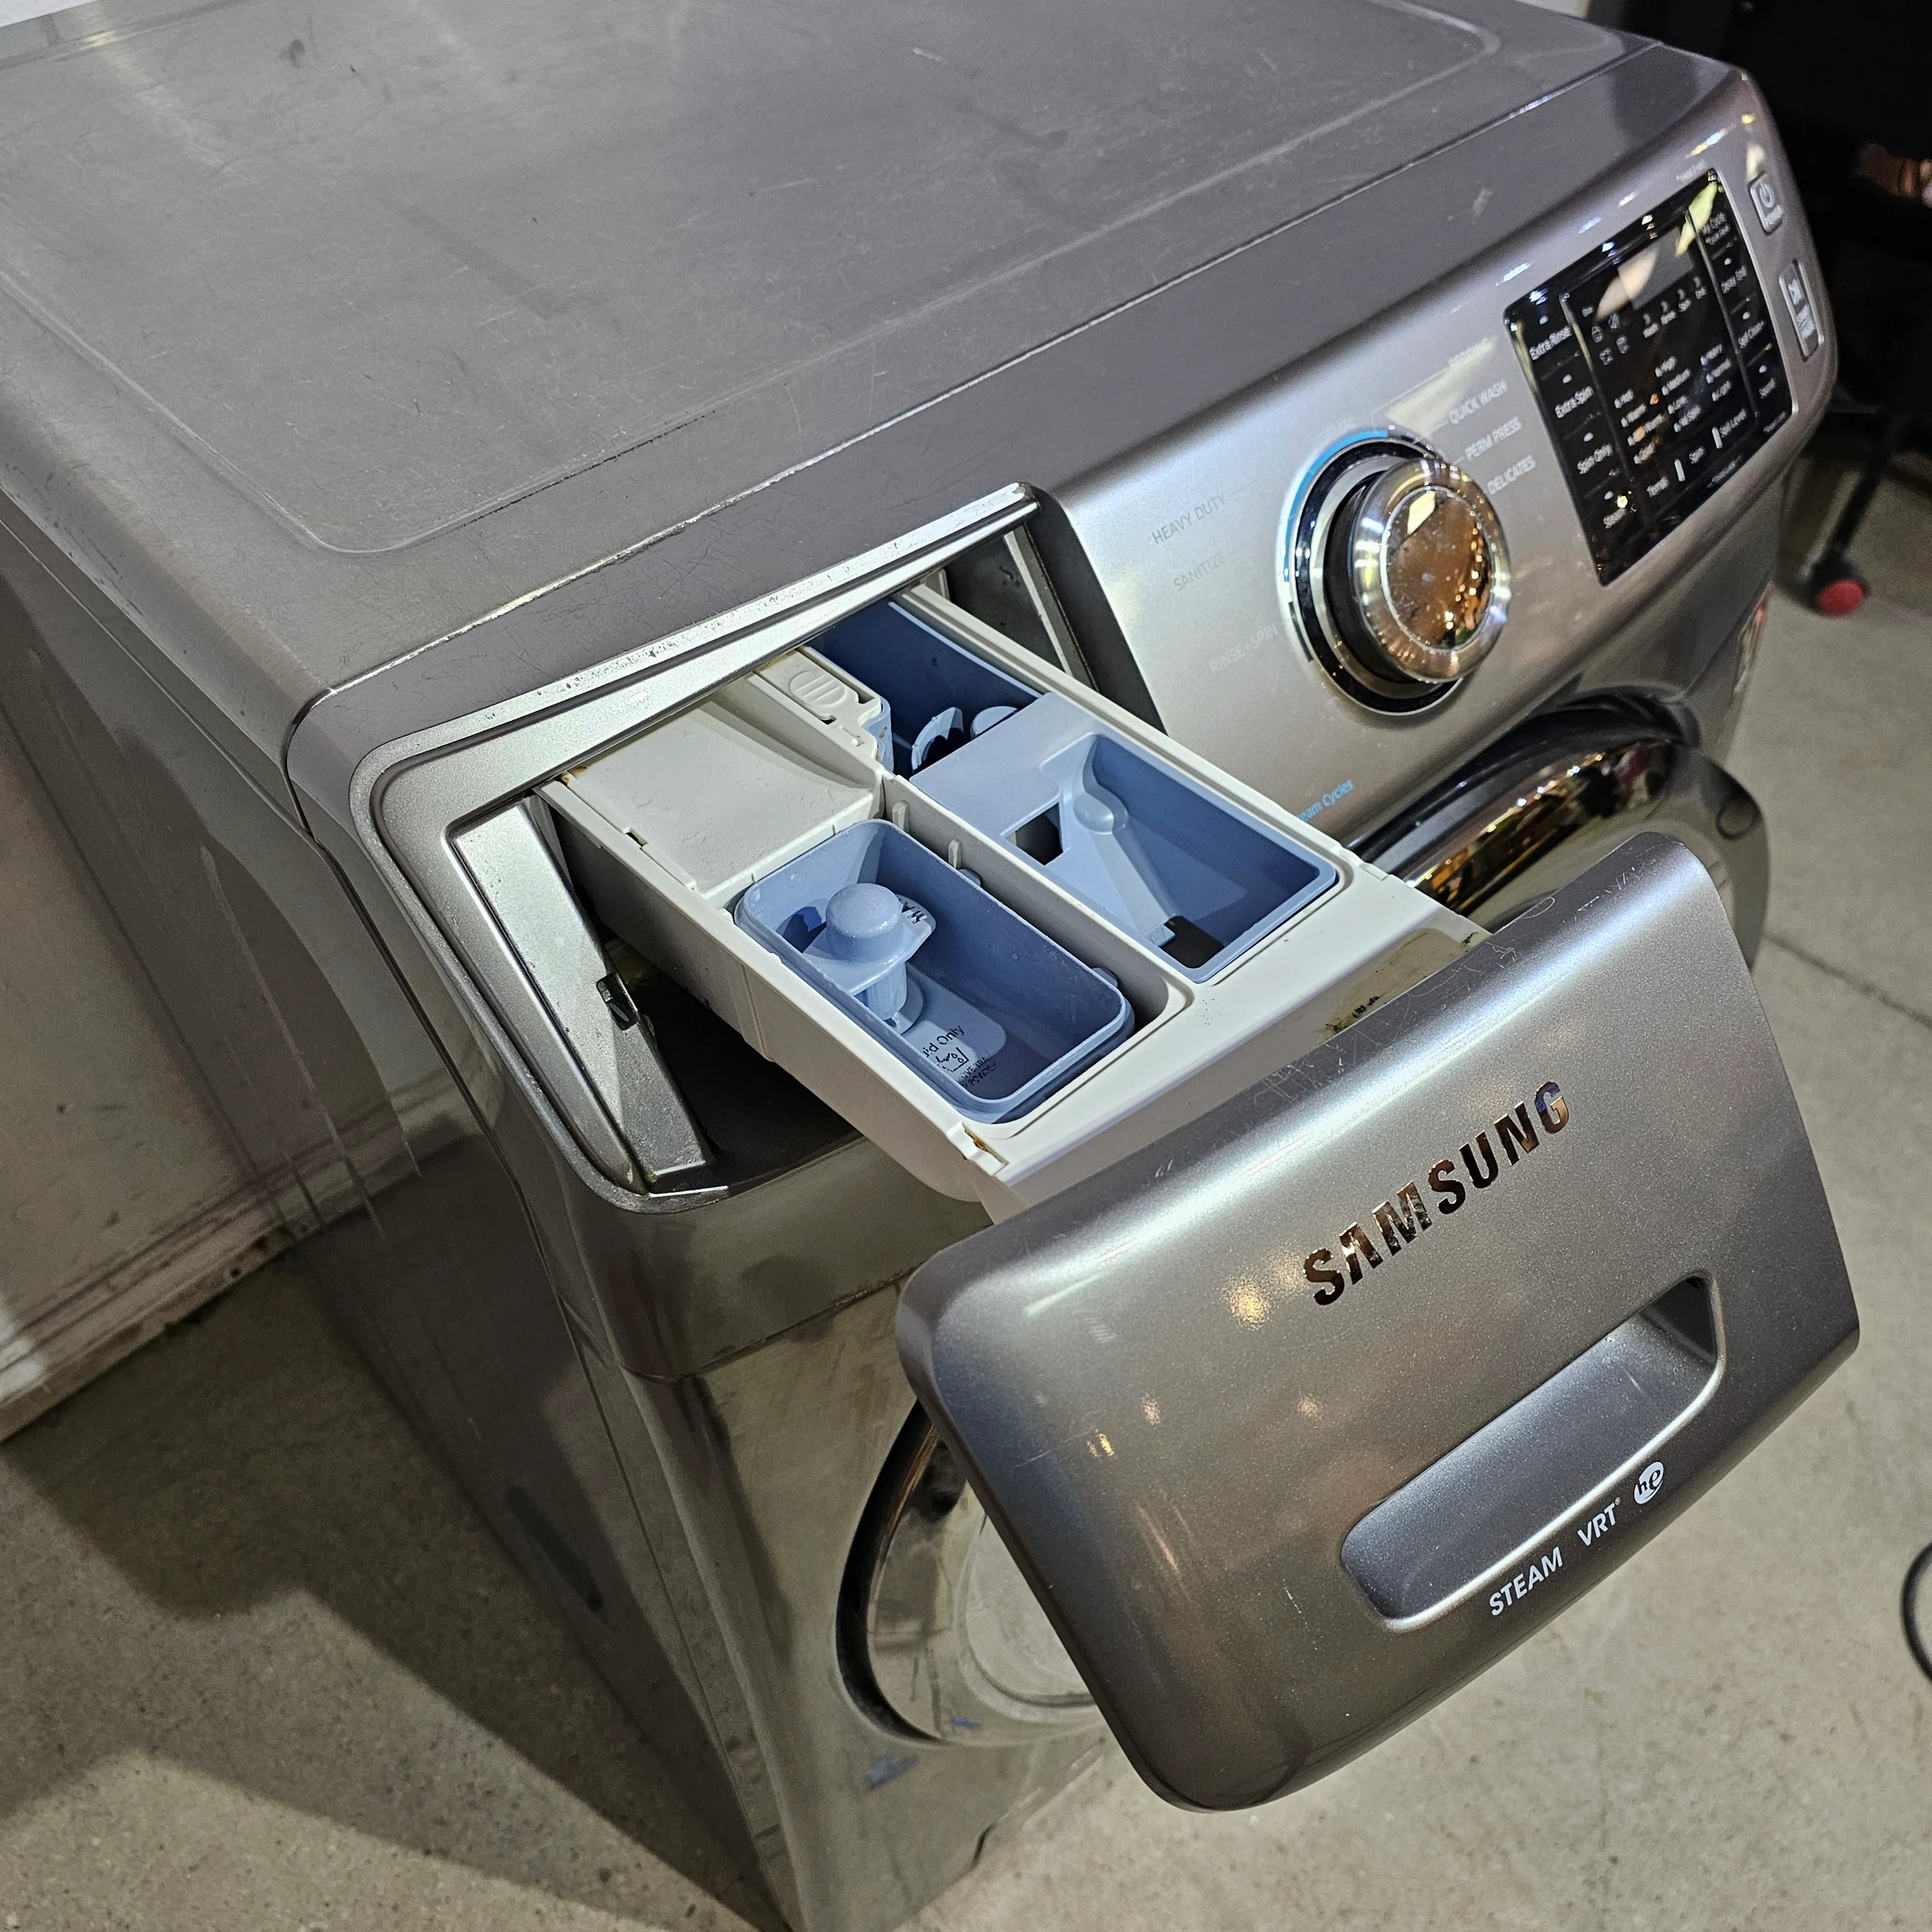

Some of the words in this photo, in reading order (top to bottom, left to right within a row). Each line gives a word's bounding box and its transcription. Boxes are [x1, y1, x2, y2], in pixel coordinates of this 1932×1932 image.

[1529, 339, 1552, 360] Extra
[1548, 325, 1572, 347] Rinse
[1449, 396, 1479, 424] QUICK
[1480, 379, 1510, 406] WASH
[1554, 395, 1578, 418] Extra
[1574, 386, 1593, 406] Spin
[1464, 434, 1494, 461] PERM
[1493, 415, 1523, 444] PRESS
[1486, 454, 1537, 495] DELICATES
[1151, 511, 1192, 545] HEAVY
[1195, 491, 1226, 520] DUTY
[1173, 552, 1226, 591] SANITIZE
[1297, 802, 1322, 822] eam
[1322, 780, 1353, 807] Cycles
[936, 1025, 965, 1045] Only
[1302, 1081, 1569, 1305] SAMSUNG
[1489, 1547, 1563, 1616] STEAM
